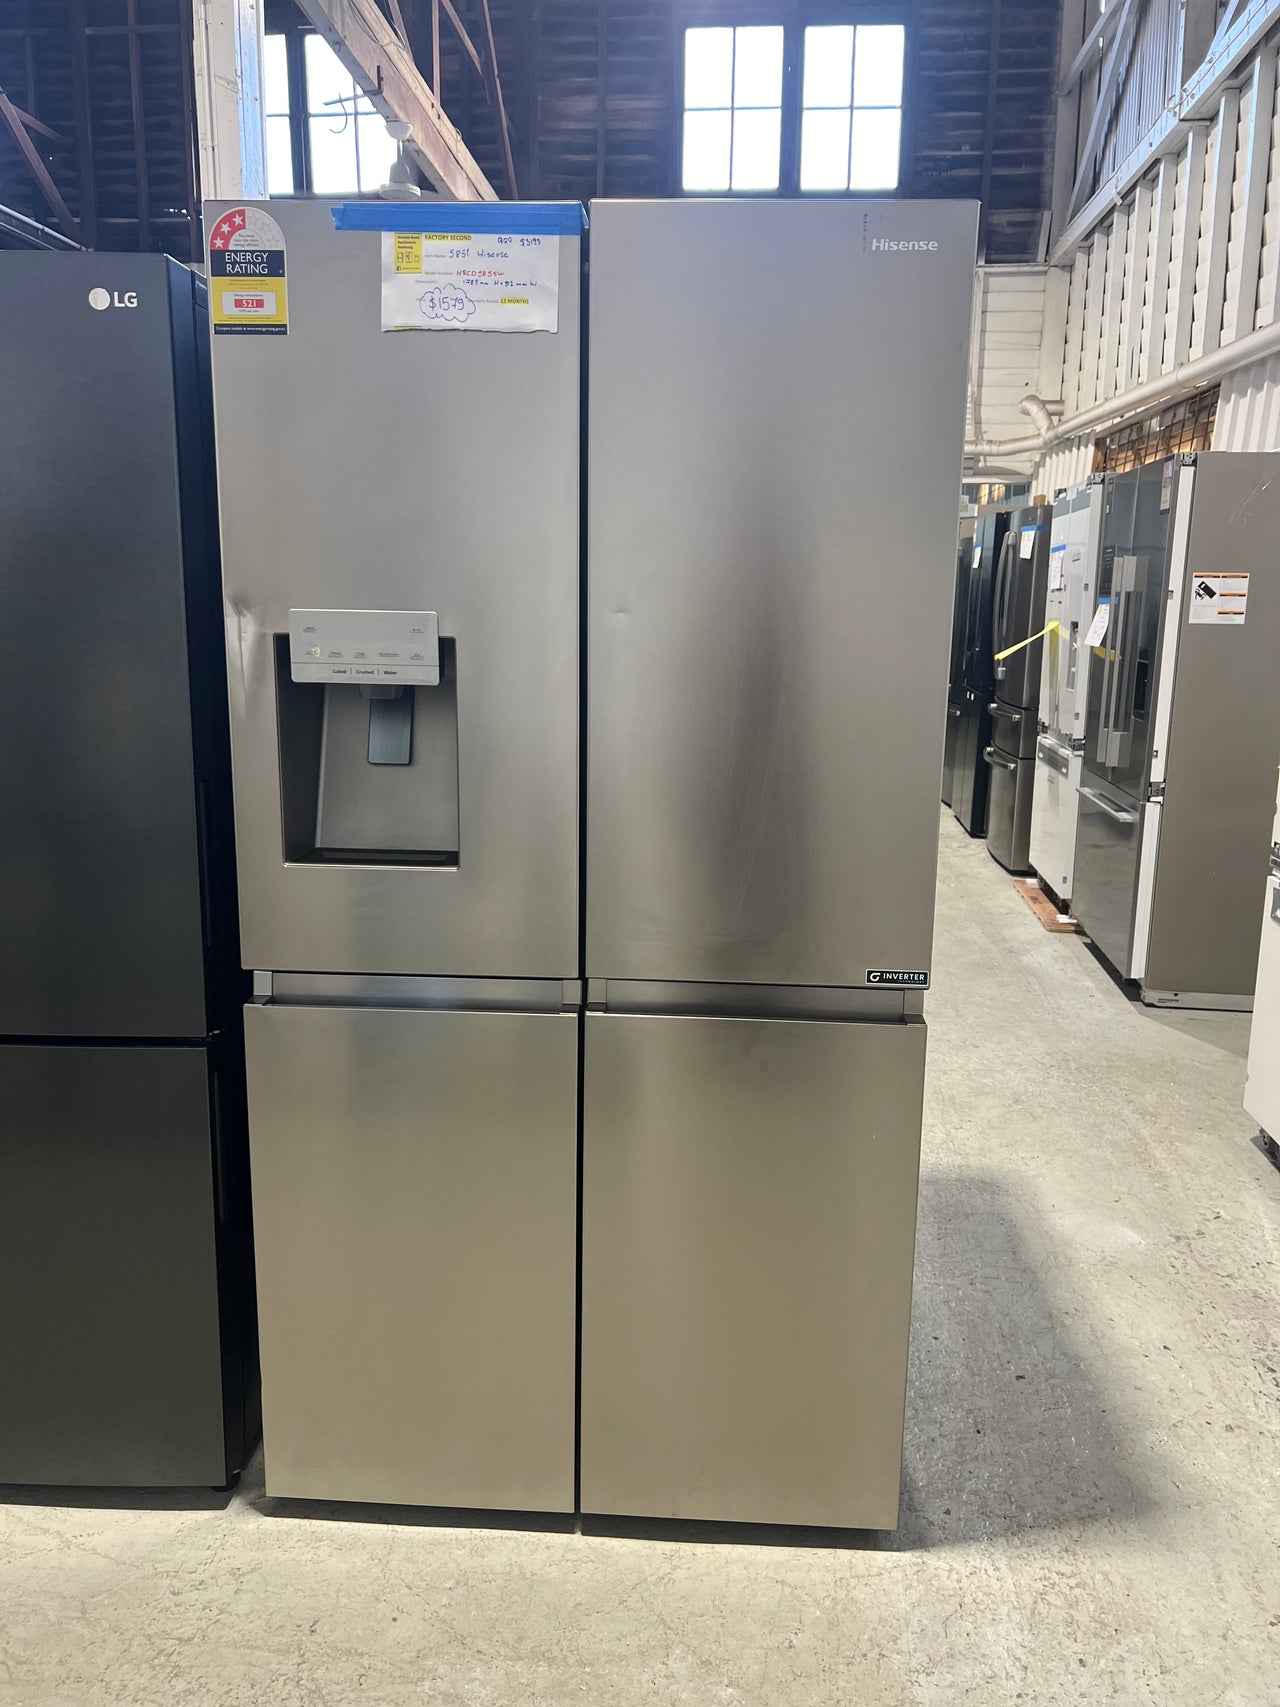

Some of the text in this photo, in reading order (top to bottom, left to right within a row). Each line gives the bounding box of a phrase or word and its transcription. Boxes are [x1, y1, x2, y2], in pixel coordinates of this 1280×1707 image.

[872, 238, 938, 250] Hisense
[226, 252, 268, 262] ENERGY
[226, 264, 268, 274] RATING
[114, 292, 138, 308] LG
[242, 300, 256, 308] 521
[428, 296, 464, 310] $1579
[883, 972, 925, 980] INVERTER
